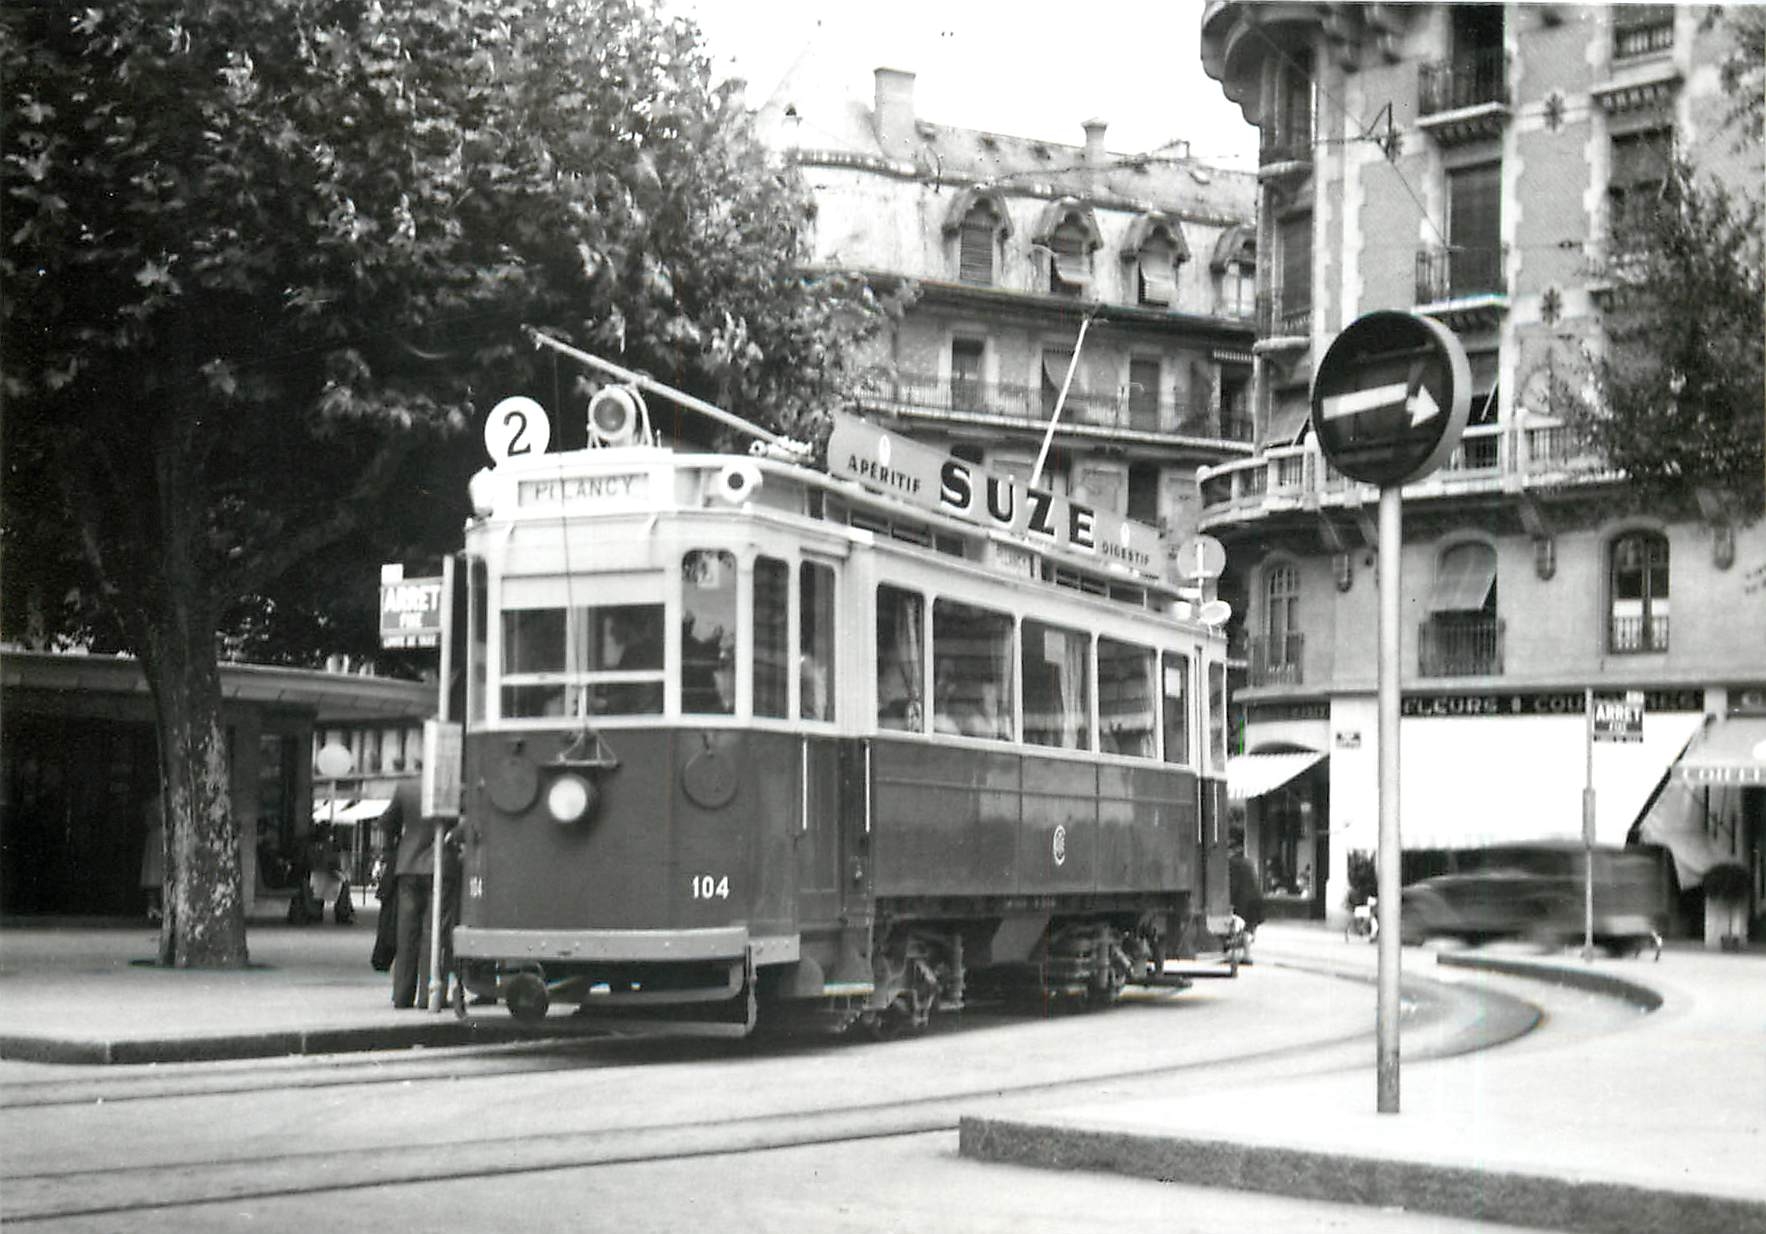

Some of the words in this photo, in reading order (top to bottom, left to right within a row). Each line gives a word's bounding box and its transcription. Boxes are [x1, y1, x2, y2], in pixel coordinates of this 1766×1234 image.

[503, 411, 531, 458] 2
[940, 460, 1095, 550] SUZE
[692, 875, 730, 899] 104
